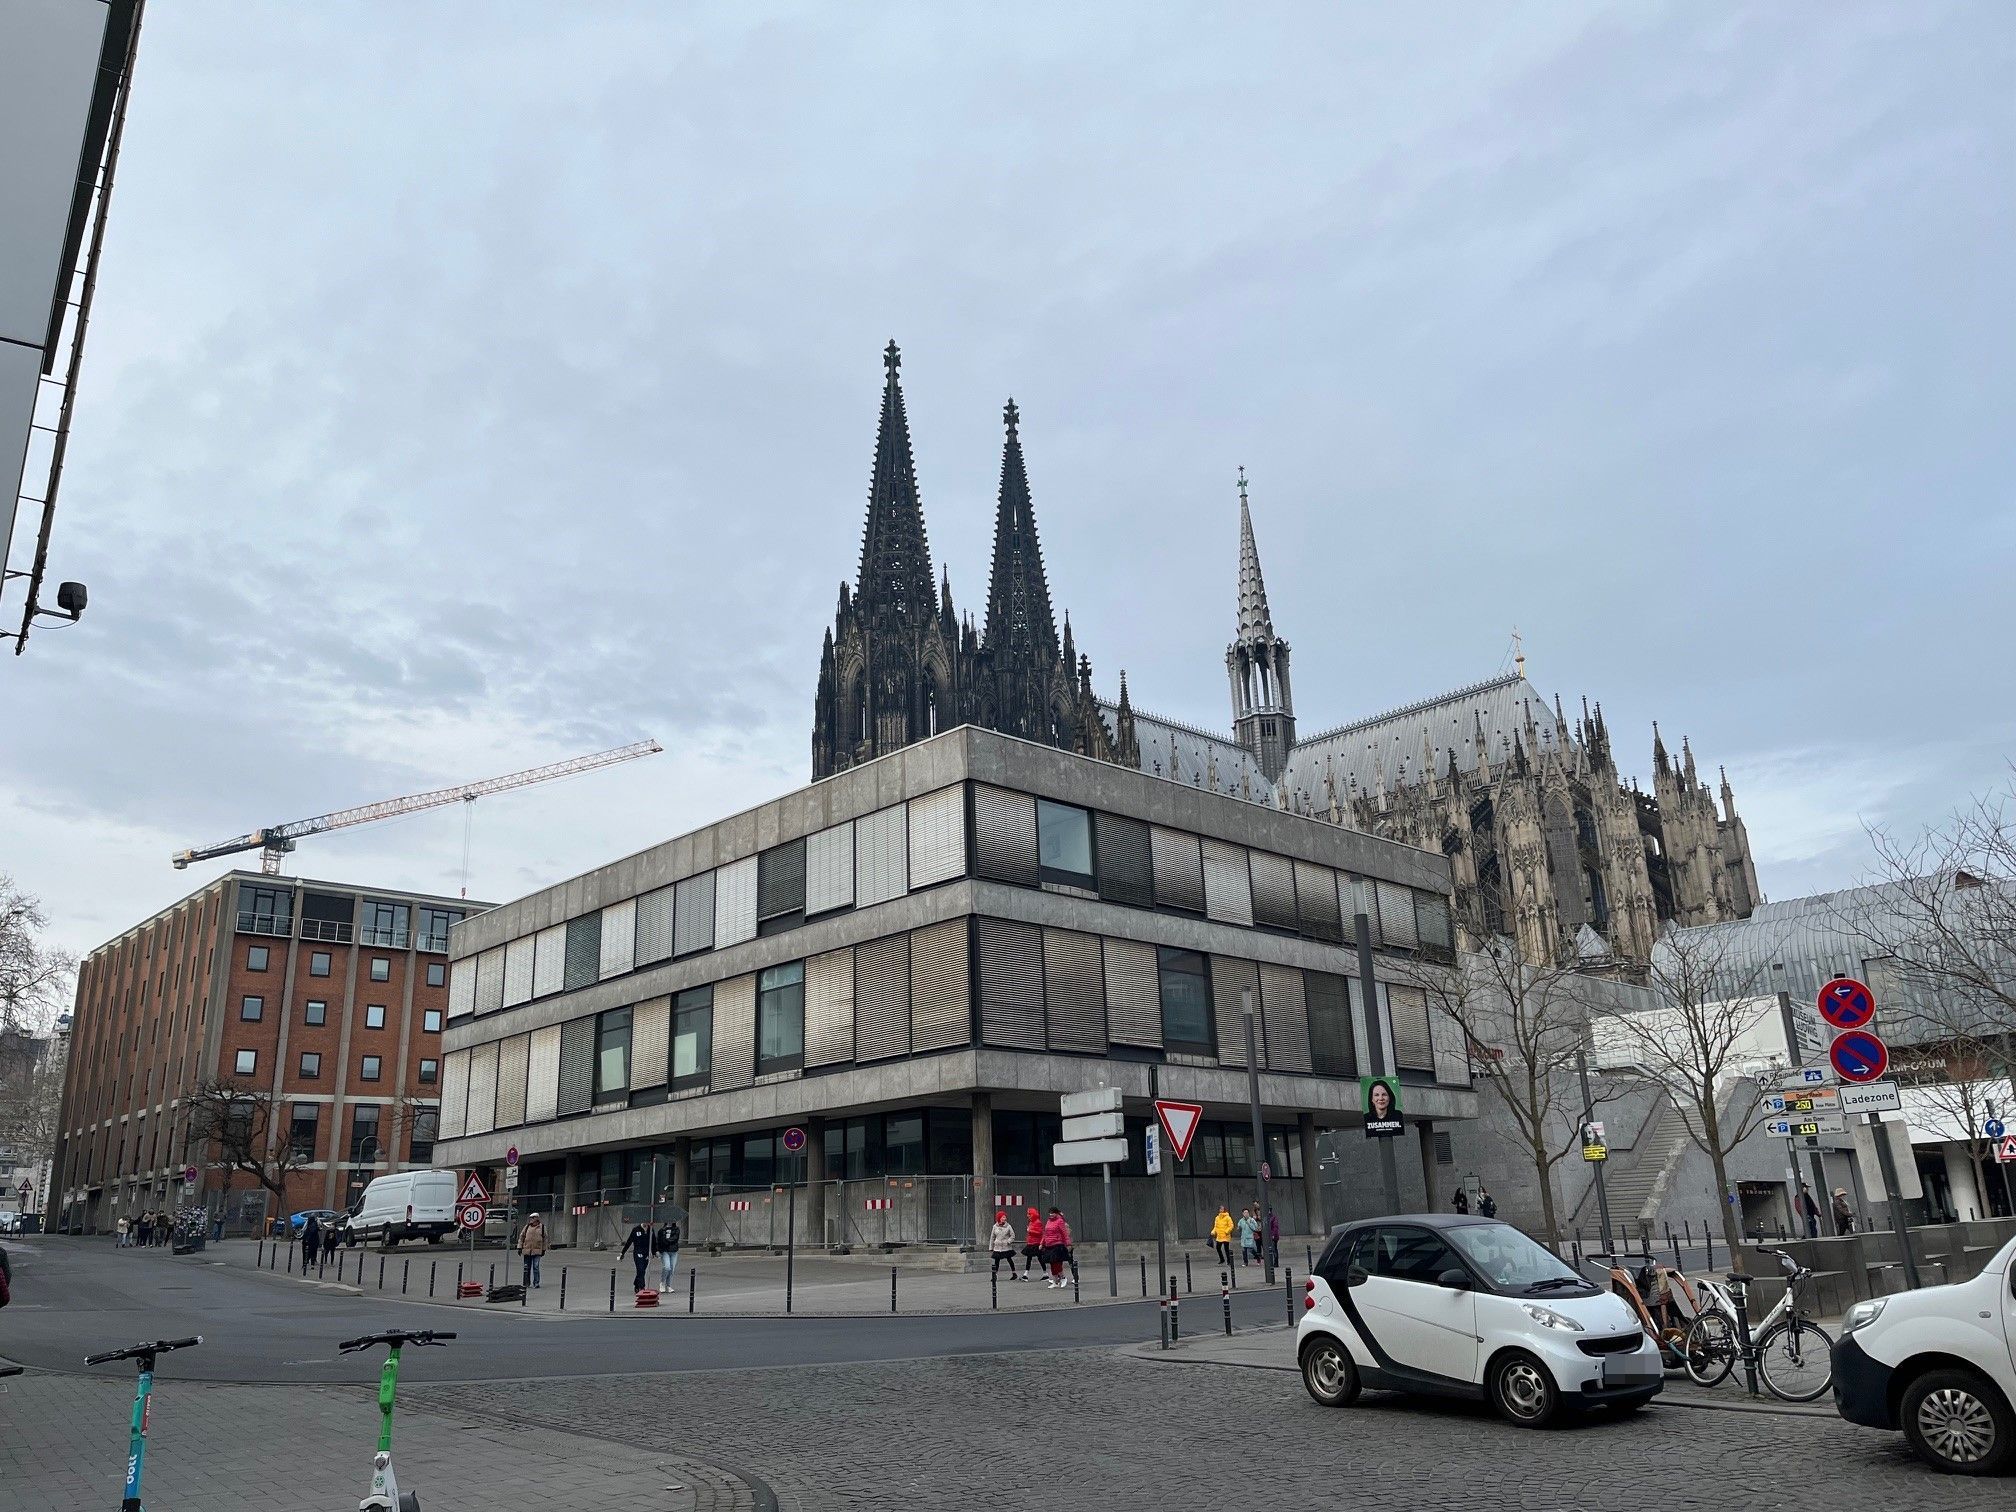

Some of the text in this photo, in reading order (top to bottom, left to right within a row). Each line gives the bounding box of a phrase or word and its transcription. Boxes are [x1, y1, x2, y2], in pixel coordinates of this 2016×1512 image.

[1844, 1093, 1895, 1105] Ladezone
[1367, 1121, 1402, 1129] ZUSAMMEN.
[1800, 1124, 1817, 1133] 119
[465, 1211, 479, 1222] 30
